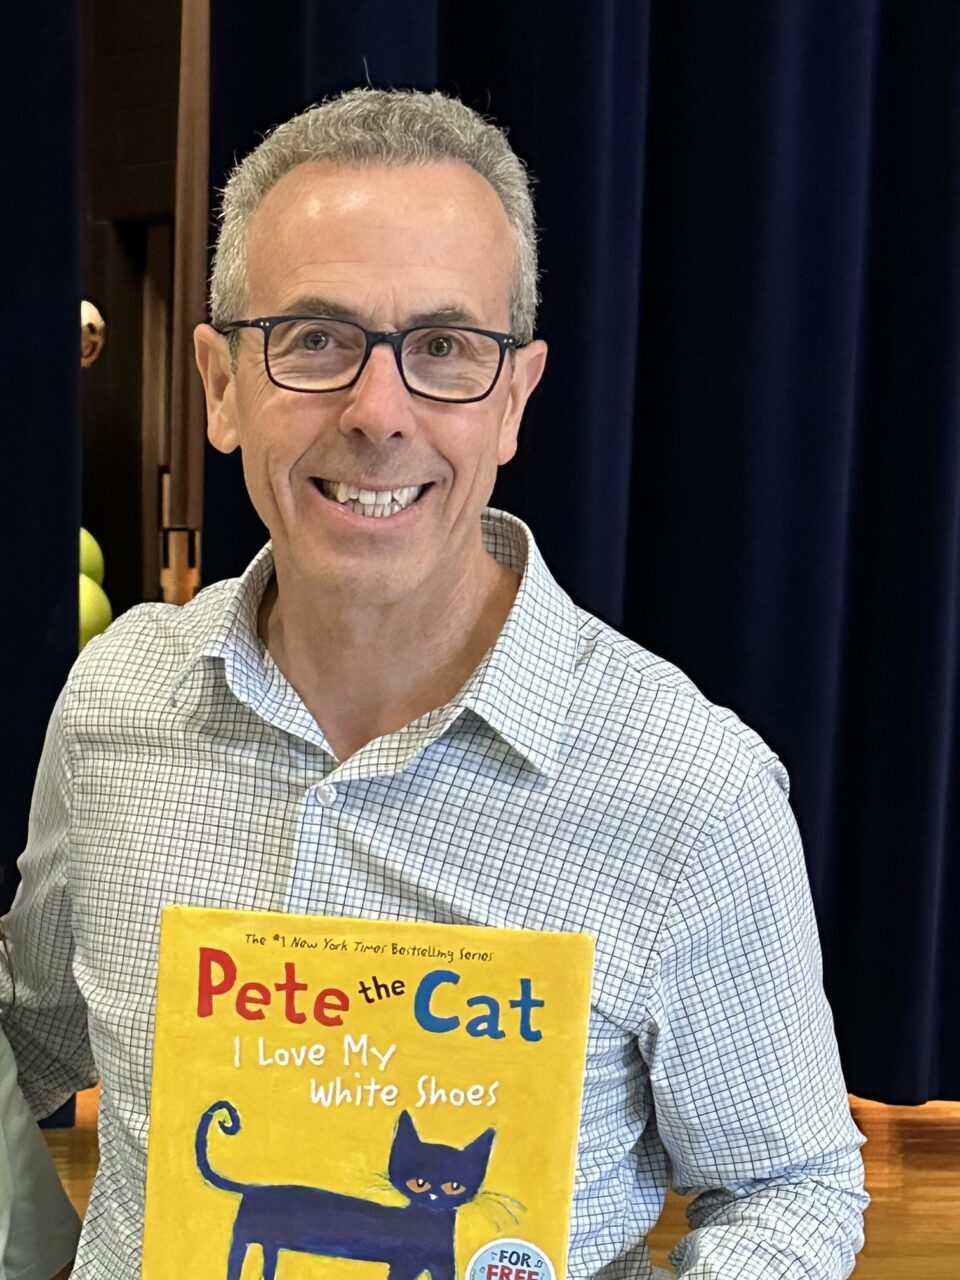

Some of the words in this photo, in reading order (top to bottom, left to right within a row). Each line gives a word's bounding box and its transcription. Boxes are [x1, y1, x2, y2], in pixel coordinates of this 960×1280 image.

[245, 933, 267, 946] The
[290, 936, 318, 949] New
[323, 938, 348, 952] York
[354, 940, 387, 954] Times
[391, 942, 455, 964] Bestselling
[459, 947, 495, 962] Series
[196, 946, 350, 1027] Pete
[358, 975, 406, 1005] the
[413, 969, 545, 1042] Cat
[233, 1036, 241, 1068] I
[258, 1037, 326, 1067] Love
[343, 1034, 397, 1071] My
[310, 1073, 399, 1107] White
[415, 1075, 500, 1107] Shoes
[498, 1249, 532, 1268] FOR
